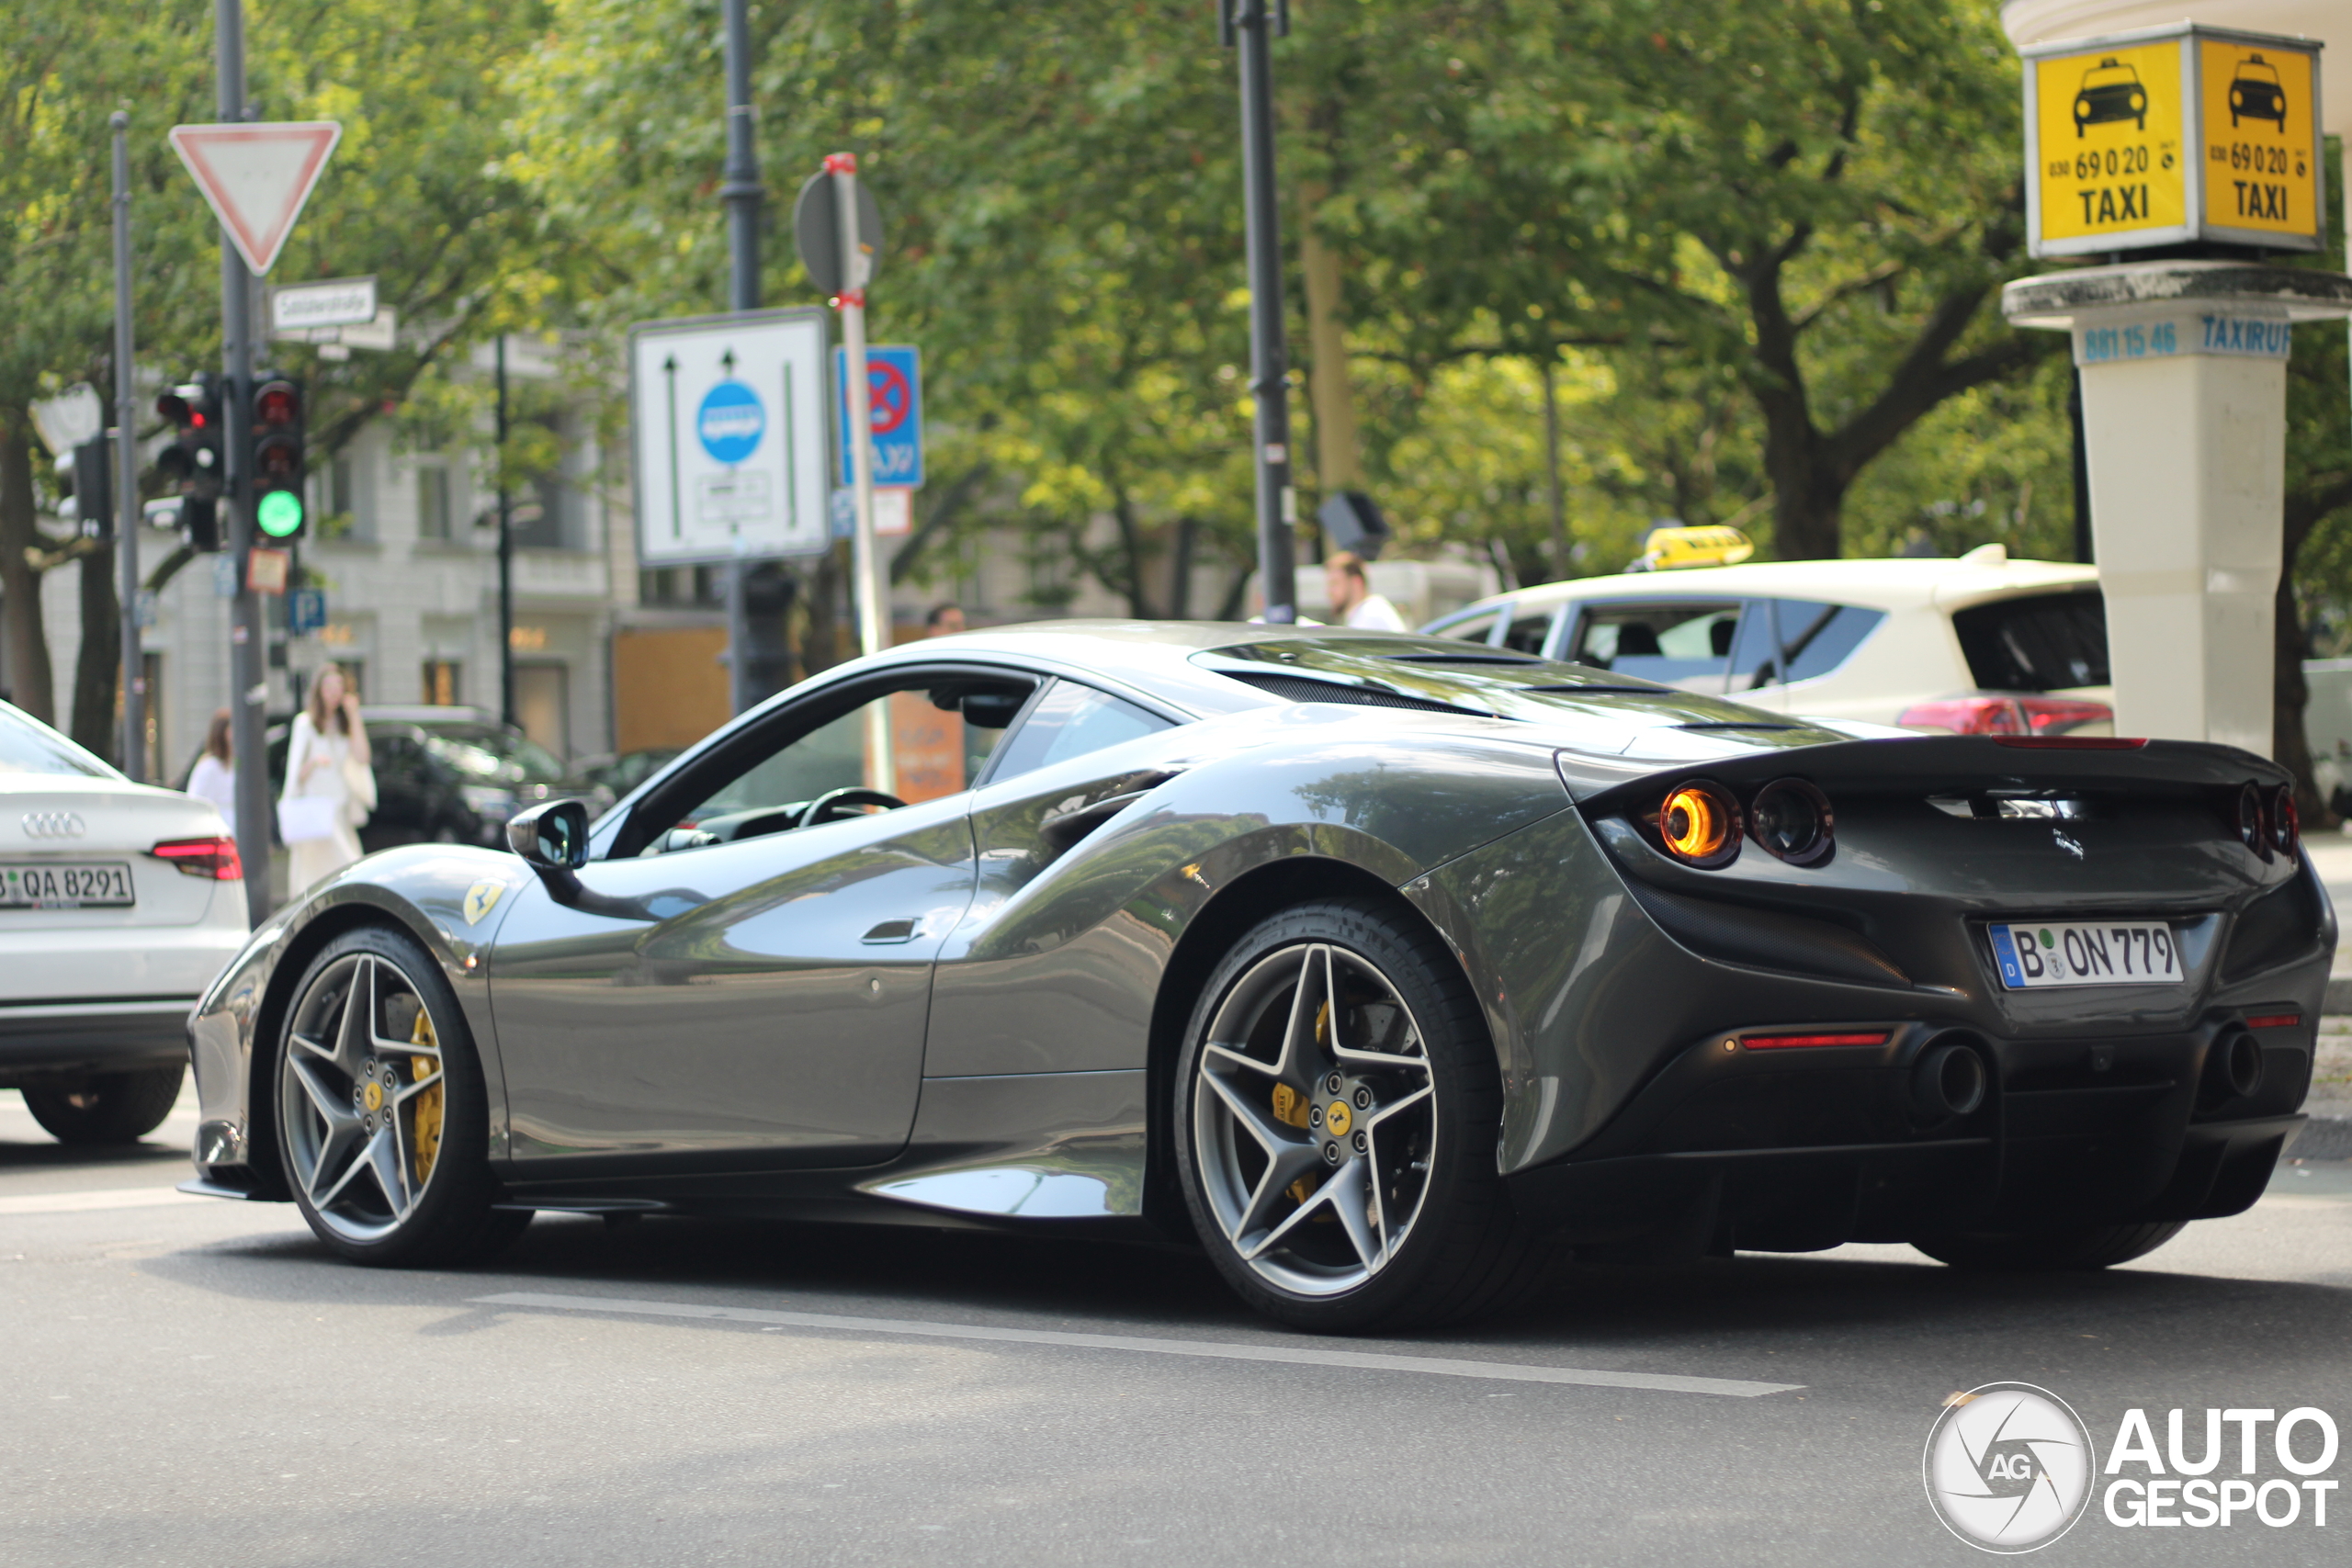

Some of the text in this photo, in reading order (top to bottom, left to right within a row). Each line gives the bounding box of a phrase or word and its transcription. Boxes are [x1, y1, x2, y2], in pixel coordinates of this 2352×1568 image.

[2078, 184, 2149, 225] TAXI
[2233, 179, 2288, 221] TAXI
[23, 870, 58, 897] QA
[64, 870, 128, 897] 8291
[2006, 963, 2016, 977] D
[2015, 928, 2173, 977] B ON 779
